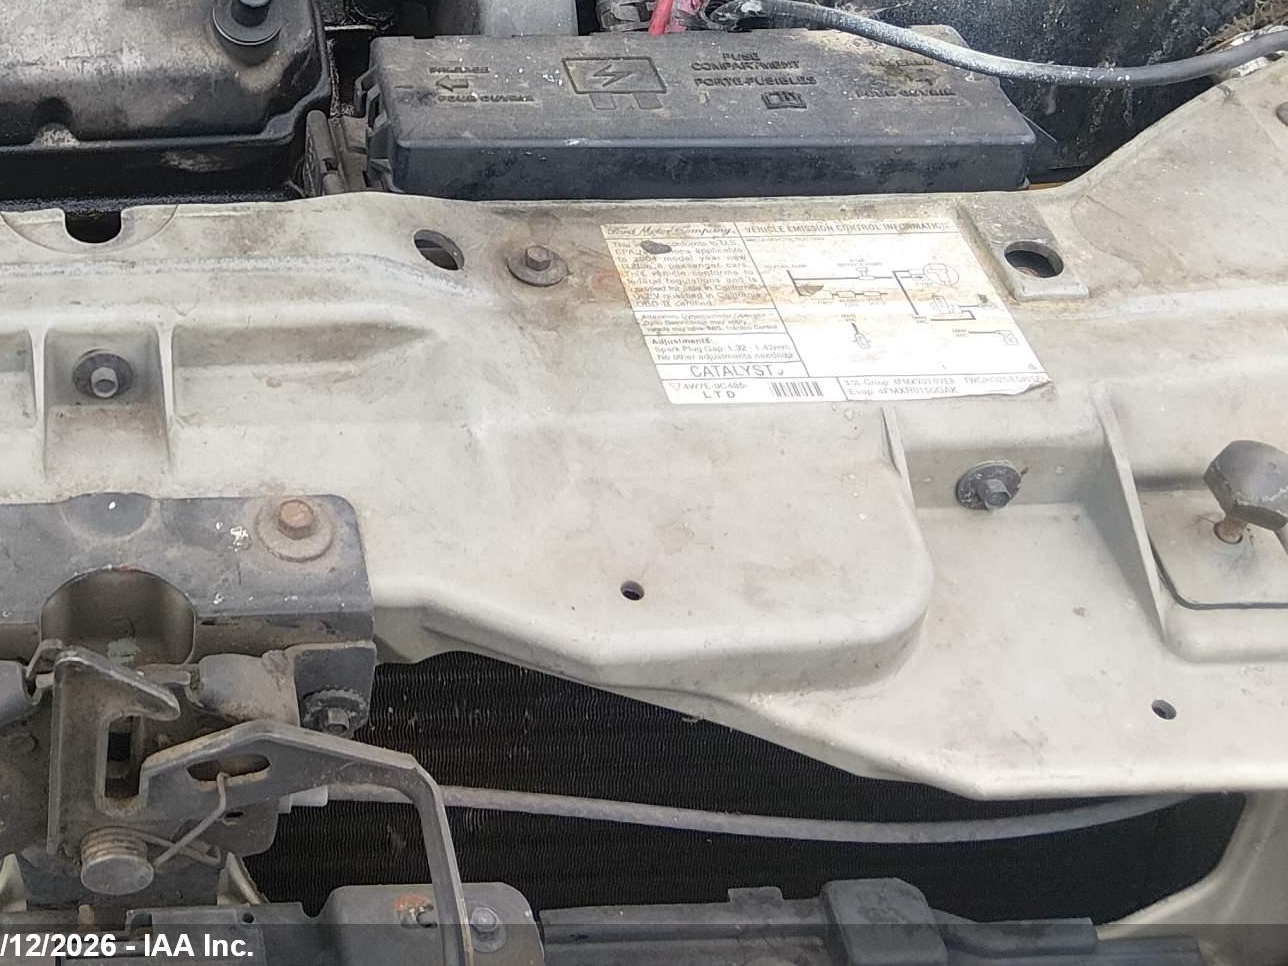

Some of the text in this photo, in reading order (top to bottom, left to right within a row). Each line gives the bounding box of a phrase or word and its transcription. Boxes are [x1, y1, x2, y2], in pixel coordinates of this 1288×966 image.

[723, 53, 760, 61] FUSE
[691, 60, 799, 70] COMPARTMENT
[745, 225, 786, 233] VEHICLE
[787, 225, 834, 233] EMISSION
[836, 224, 880, 233] CONTROL
[690, 365, 773, 377] CATALYST
